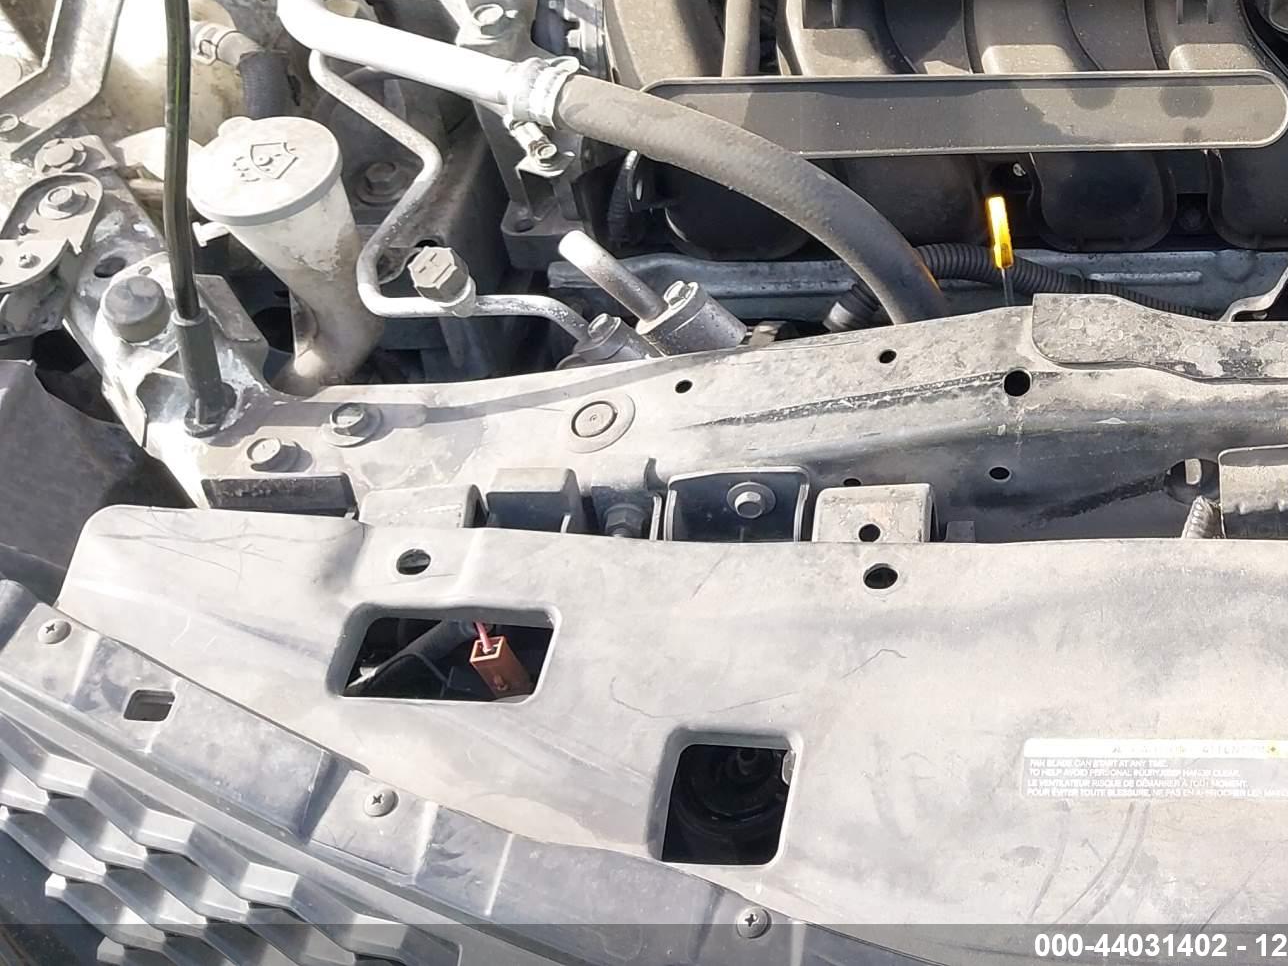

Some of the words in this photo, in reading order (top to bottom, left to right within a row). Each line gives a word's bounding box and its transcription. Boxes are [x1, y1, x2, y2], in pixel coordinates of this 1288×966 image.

[1119, 759, 1129, 768] AT
[1130, 759, 1147, 768] ANY
[1029, 768, 1041, 777] TO
[1041, 768, 1063, 777] HELP
